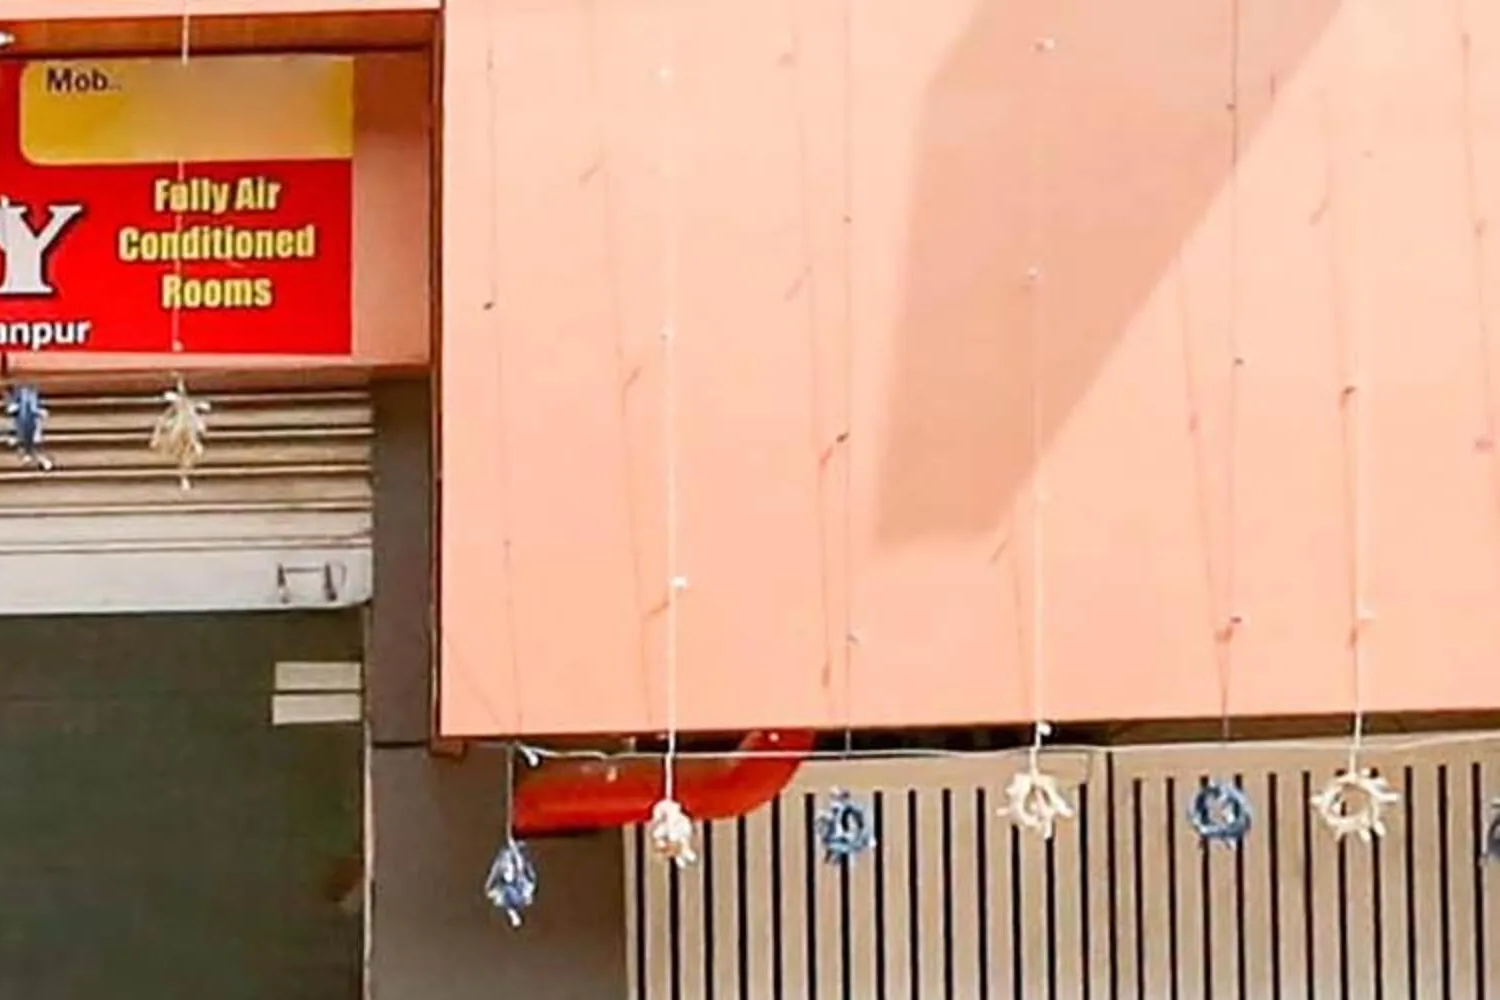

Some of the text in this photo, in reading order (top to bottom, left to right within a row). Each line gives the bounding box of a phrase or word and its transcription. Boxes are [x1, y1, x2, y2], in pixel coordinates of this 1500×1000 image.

[234, 176, 281, 210] Air
[118, 224, 315, 261] Conditioned
[161, 274, 273, 308] Rooms
